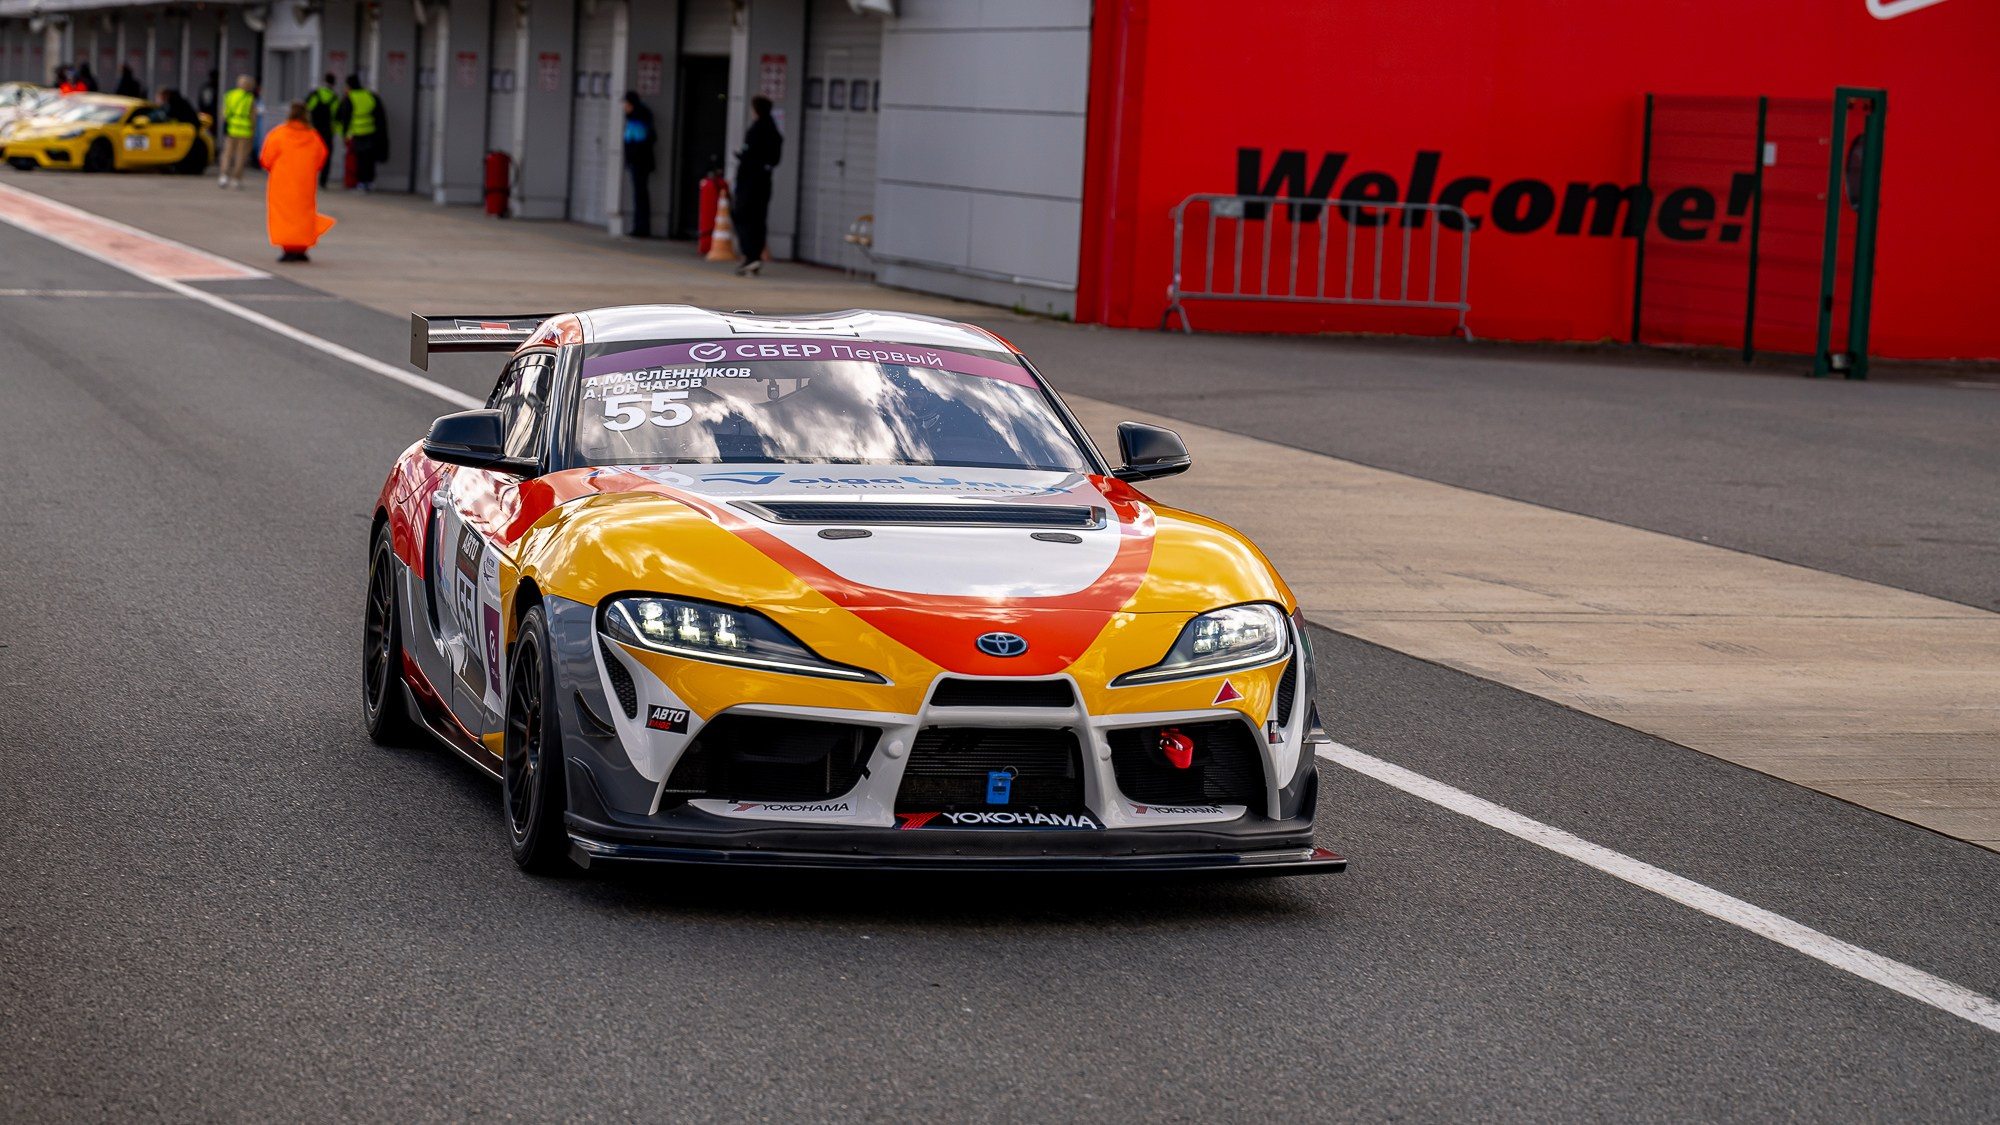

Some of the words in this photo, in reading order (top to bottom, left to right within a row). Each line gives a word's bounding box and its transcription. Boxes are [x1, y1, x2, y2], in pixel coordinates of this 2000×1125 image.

[1236, 147, 1757, 242] Welcome!
[736, 344, 821, 358] СБЕР
[830, 345, 944, 366] Первый
[586, 367, 751, 388] А.МАСЛЕННИКОВ
[583, 378, 703, 401] А.ГОНЧАРОВ
[602, 390, 693, 432] 55
[461, 531, 479, 561] АВТО
[459, 577, 476, 649] 55
[652, 707, 686, 723] АВТО
[763, 803, 849, 812] YOKOHAMA
[1151, 806, 1224, 815] YOKOHAMA
[942, 812, 1098, 830] YOKOHAMA
